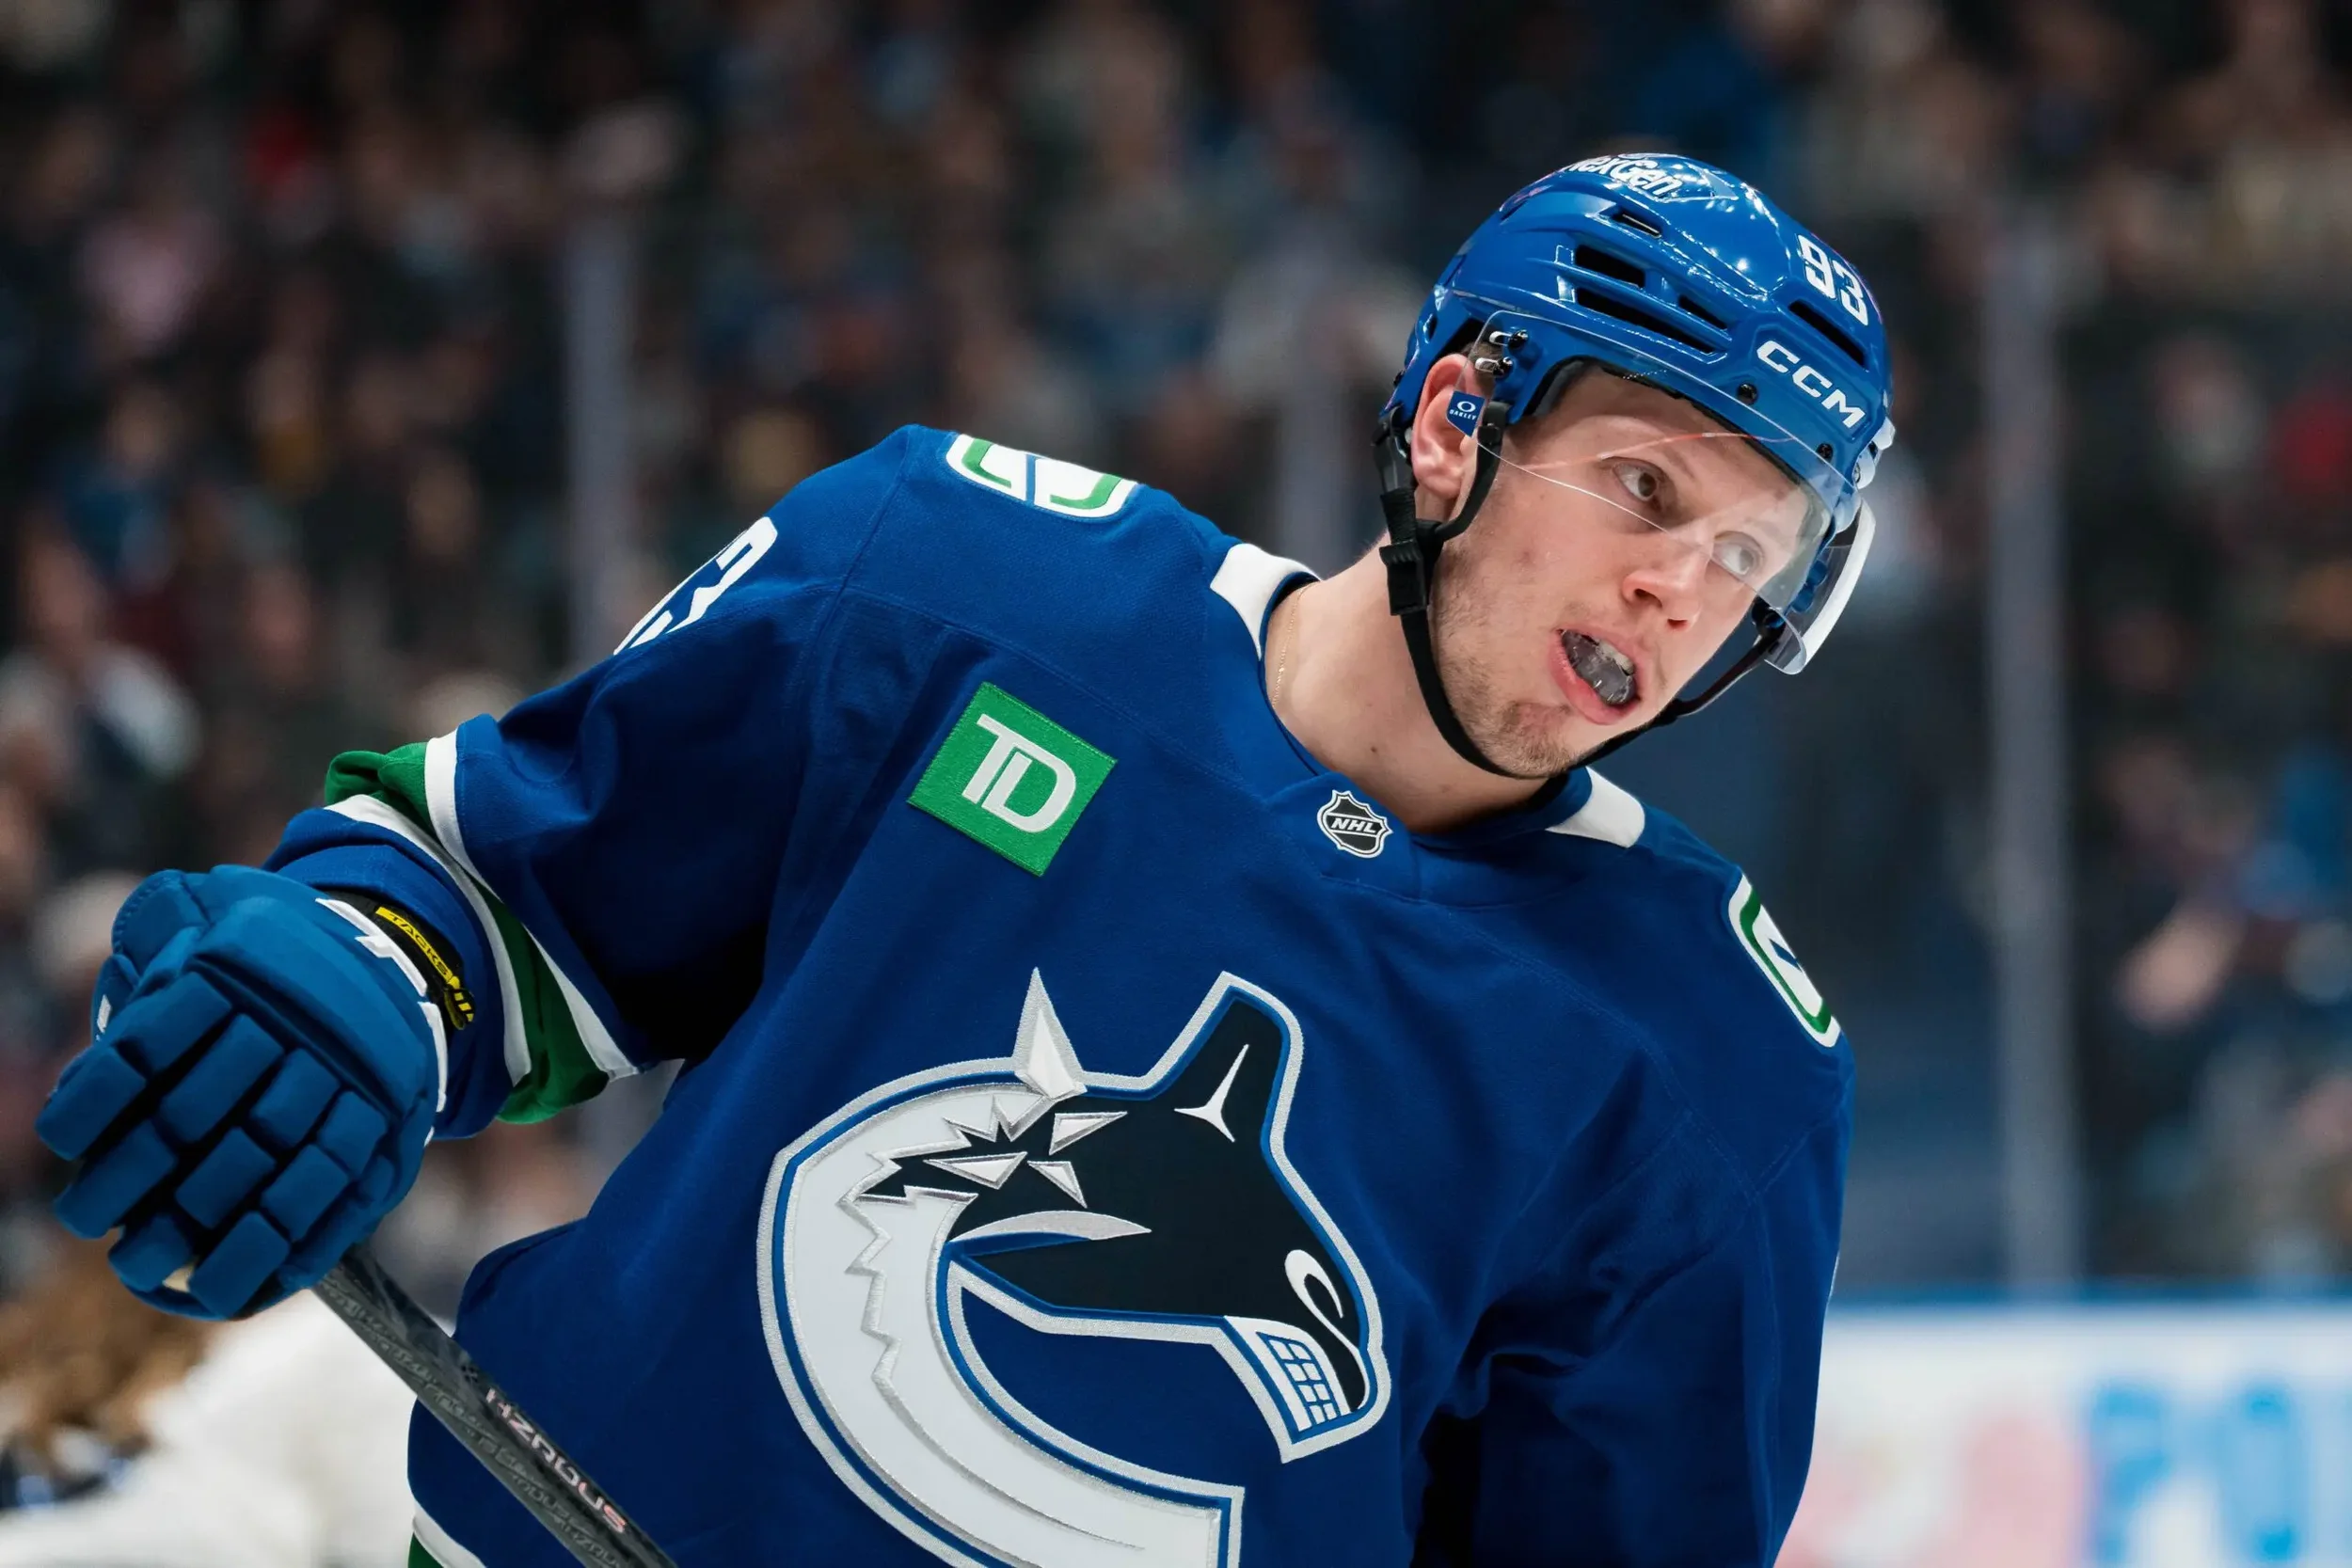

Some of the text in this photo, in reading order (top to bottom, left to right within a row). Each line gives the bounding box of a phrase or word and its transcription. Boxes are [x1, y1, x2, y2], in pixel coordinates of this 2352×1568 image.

[1798, 235, 1869, 326] 93
[1756, 340, 1866, 429] CCM
[961, 713, 1077, 833] TD
[1331, 817, 1376, 834] NHL
[389, 912, 449, 976] TACKS
